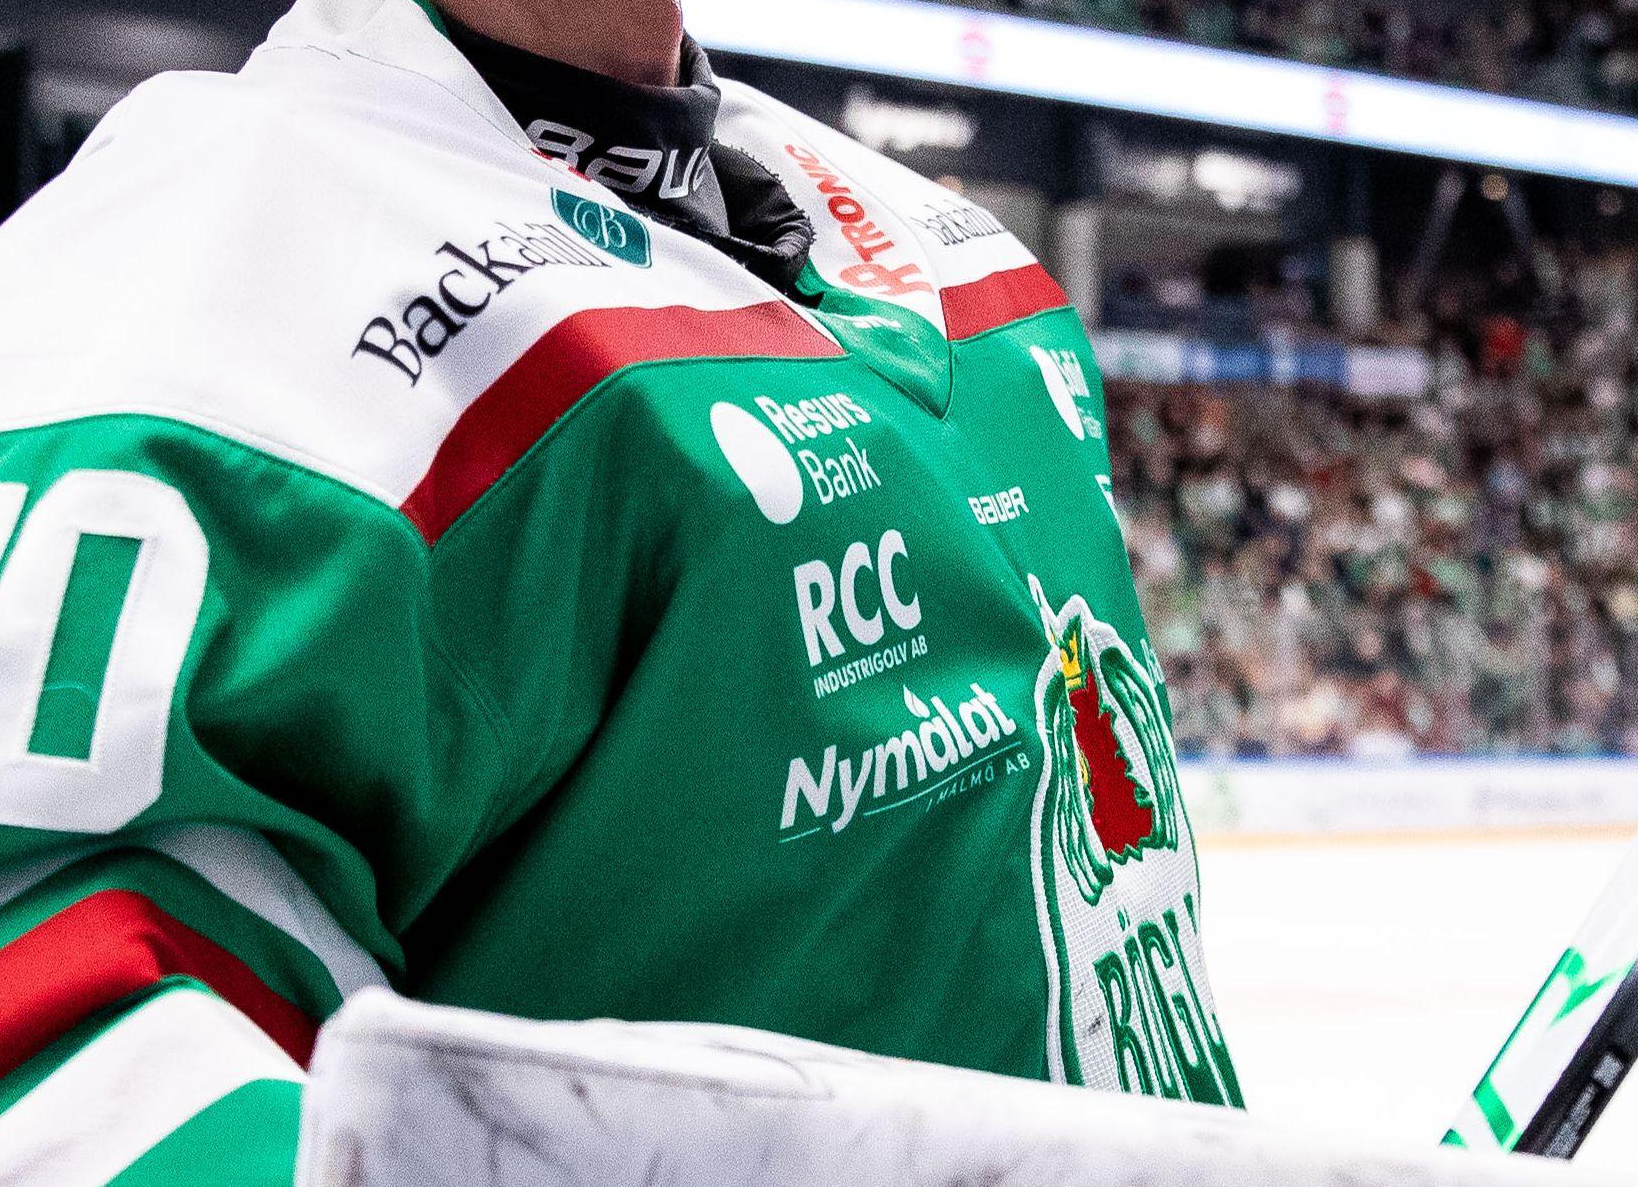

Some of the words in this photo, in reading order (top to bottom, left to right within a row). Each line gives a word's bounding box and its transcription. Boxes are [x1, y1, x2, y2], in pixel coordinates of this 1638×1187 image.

[785, 143, 895, 263] TRONIC
[754, 392, 872, 444] Resurs
[797, 436, 882, 506] Bank
[793, 528, 922, 668] RCC
[813, 641, 908, 700] INDUSTRIGOLV
[911, 634, 929, 659] AB
[1005, 752, 1031, 776] AB
[1091, 892, 1248, 1112] RÖGL
